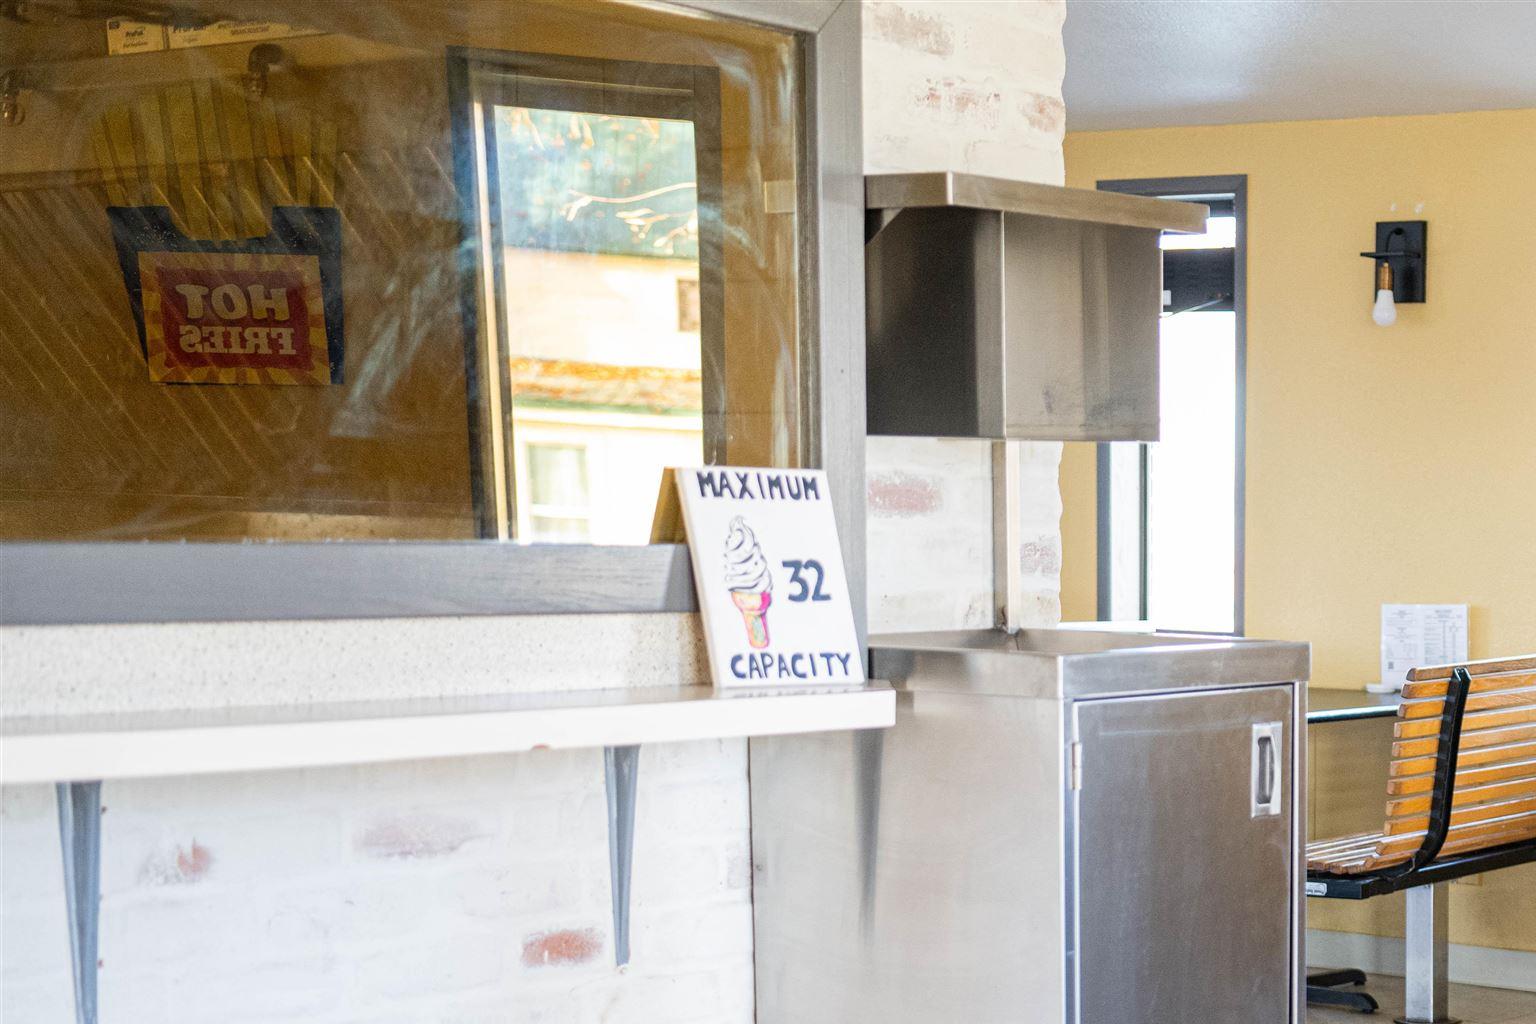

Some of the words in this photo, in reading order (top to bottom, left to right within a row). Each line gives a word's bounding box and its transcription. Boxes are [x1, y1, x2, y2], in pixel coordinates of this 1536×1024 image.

[696, 471, 820, 500] MAXIMUM
[782, 559, 831, 602] 32
[730, 652, 851, 679] CAPACITY
